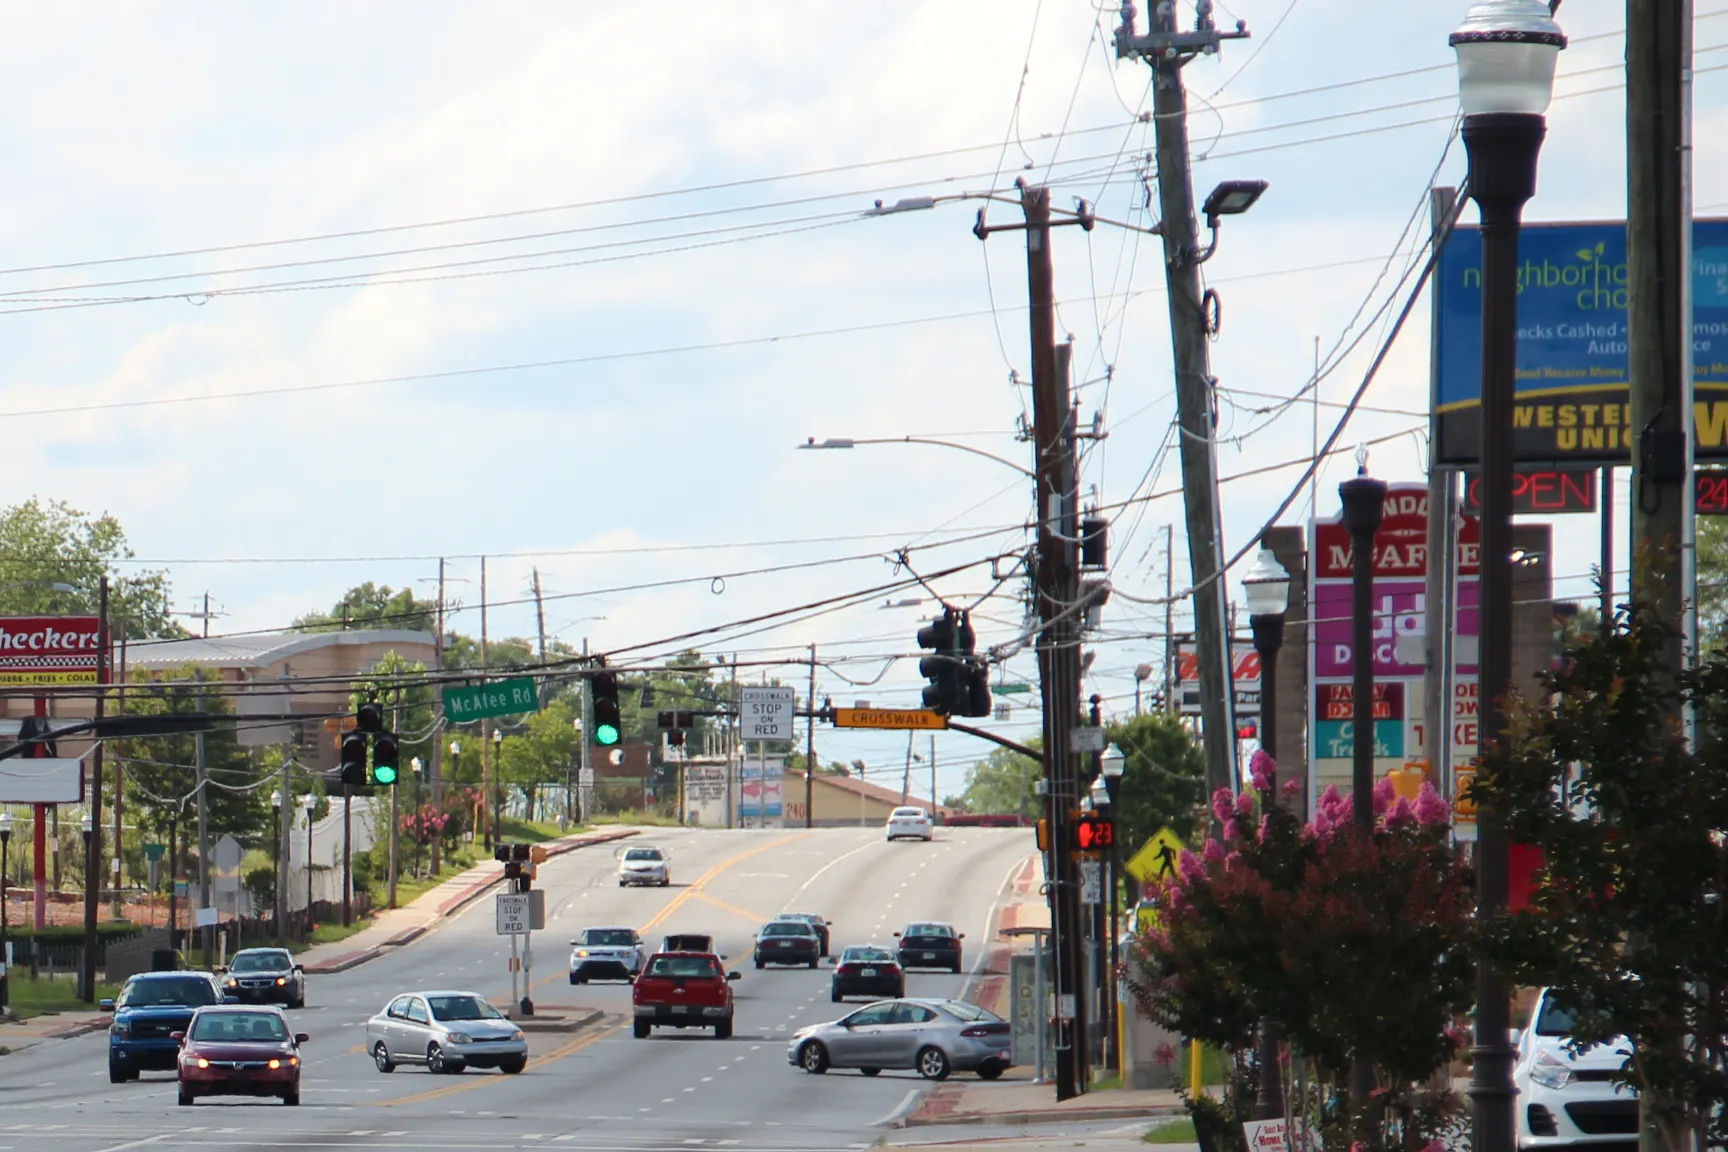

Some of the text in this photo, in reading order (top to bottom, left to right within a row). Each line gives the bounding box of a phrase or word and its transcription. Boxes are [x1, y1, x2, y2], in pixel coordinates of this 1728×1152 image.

[1557, 323, 1617, 339] Cashed
[33, 674, 57, 683] FRIES
[66, 673, 96, 682] COLAS
[451, 687, 532, 714] McAfee Rd
[744, 691, 790, 701] CROSSWALK
[752, 703, 782, 715] STOP
[761, 715, 774, 723] ON
[852, 712, 929, 726] CROSSWALK
[755, 724, 778, 736] RED
[1094, 821, 1113, 845] 23
[504, 906, 523, 914] STOP
[505, 922, 523, 931] RED
